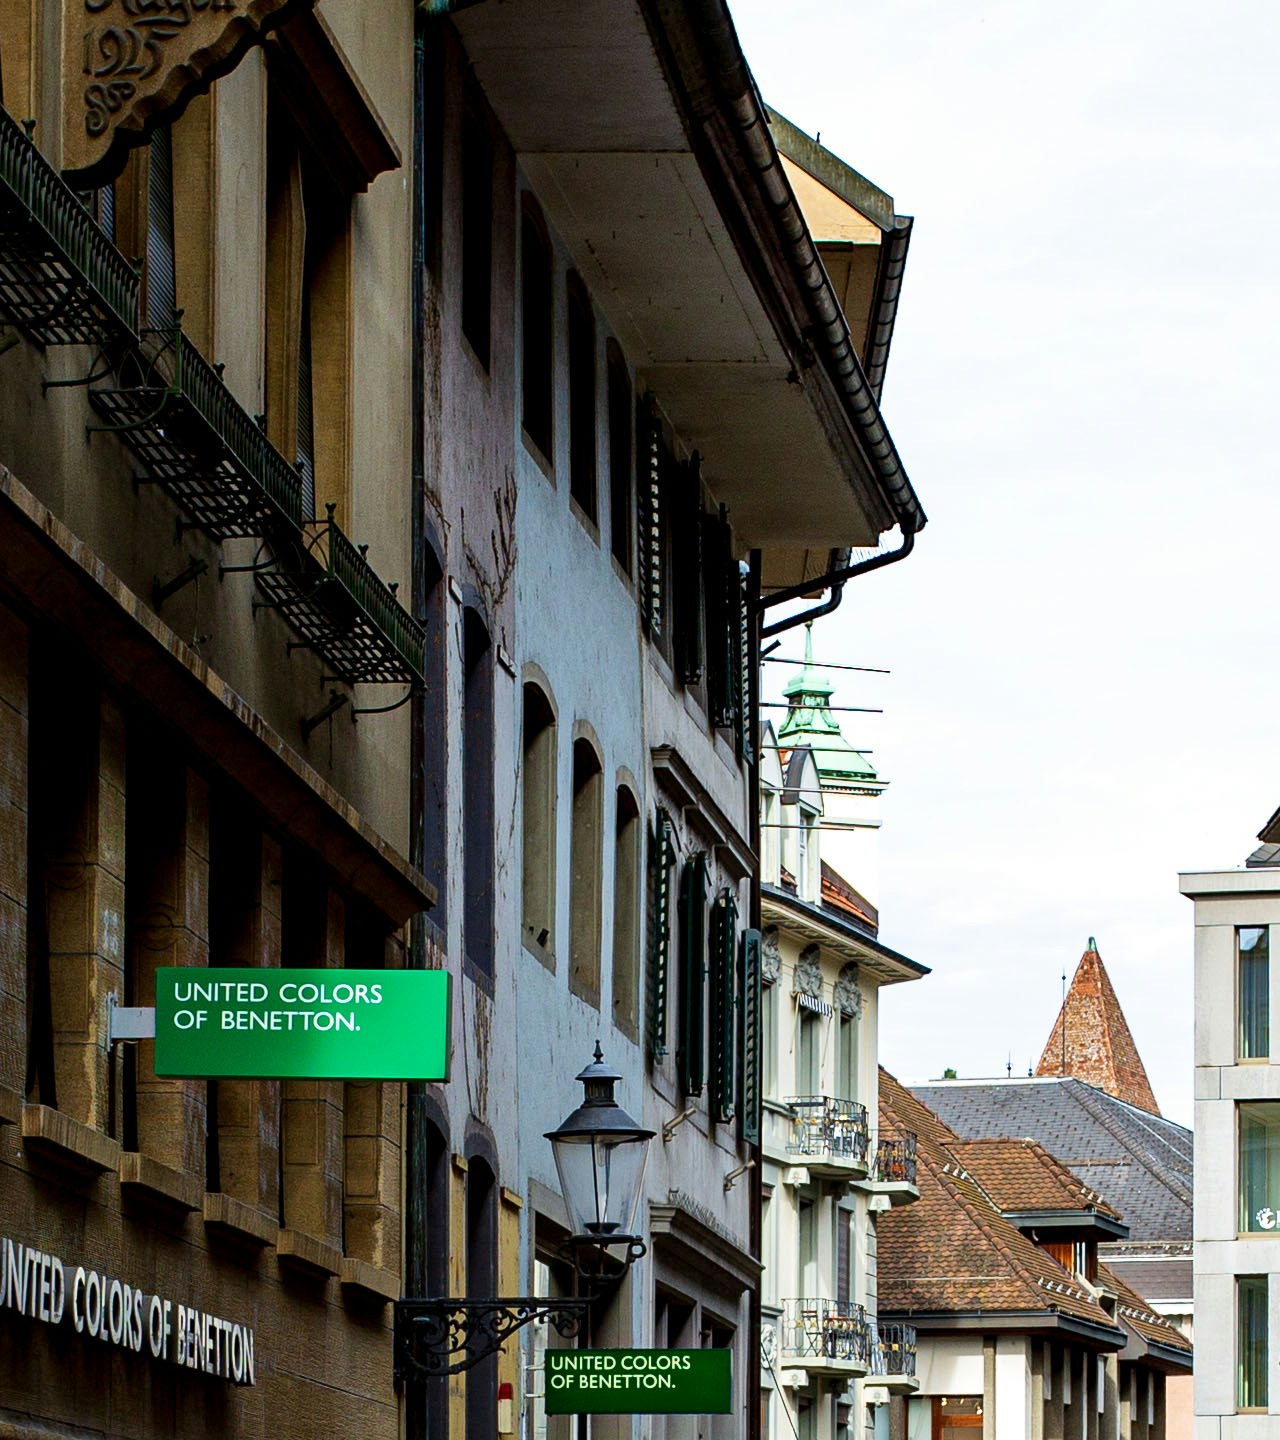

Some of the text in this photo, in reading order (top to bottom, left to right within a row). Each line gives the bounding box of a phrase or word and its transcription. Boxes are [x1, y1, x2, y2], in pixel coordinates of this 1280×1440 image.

[173, 982, 383, 1004] UNITED COLORS
[173, 1009, 362, 1032] OF BENETTON.
[72, 1265, 143, 1353] COLORS
[148, 1294, 172, 1360] OF
[176, 1303, 257, 1386] BENETTON
[550, 1355, 692, 1371] UNITED COLORS
[550, 1374, 677, 1389] OF BENETTON.
